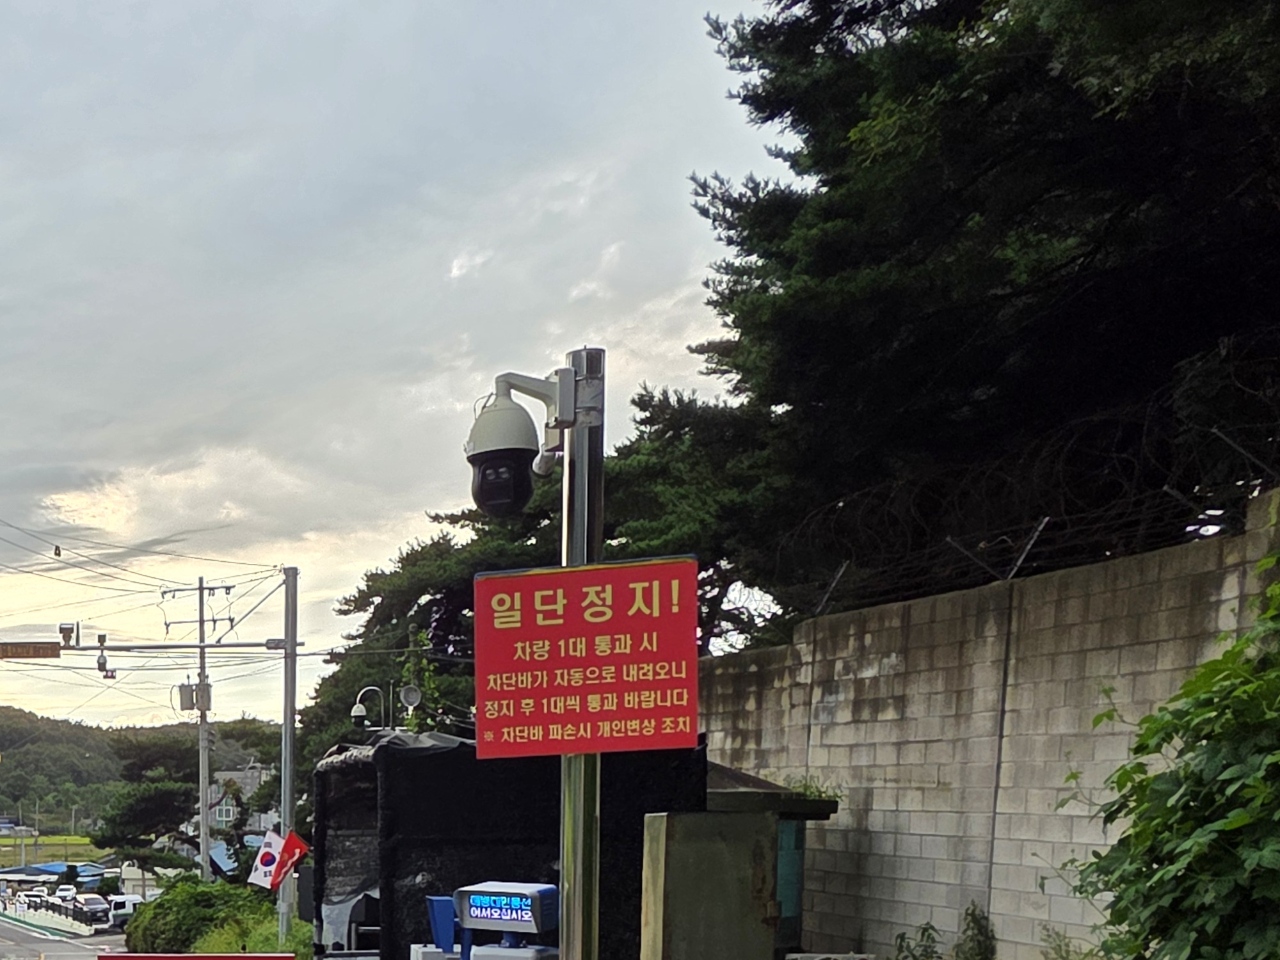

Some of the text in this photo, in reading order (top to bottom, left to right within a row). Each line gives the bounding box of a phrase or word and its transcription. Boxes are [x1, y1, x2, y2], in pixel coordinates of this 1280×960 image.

[513, 632, 658, 661] 차량 1대 통과 시
[486, 660, 687, 691] 차단바가 자동으로 내려오니
[484, 688, 689, 719] 정지 후 1대씩 통과 바랍니다
[501, 726, 543, 744] 차단바
[549, 722, 591, 741] 파손시
[597, 719, 656, 738] 개인변상
[661, 716, 690, 734] 조치
[470, 907, 533, 921] 어서오십시오
